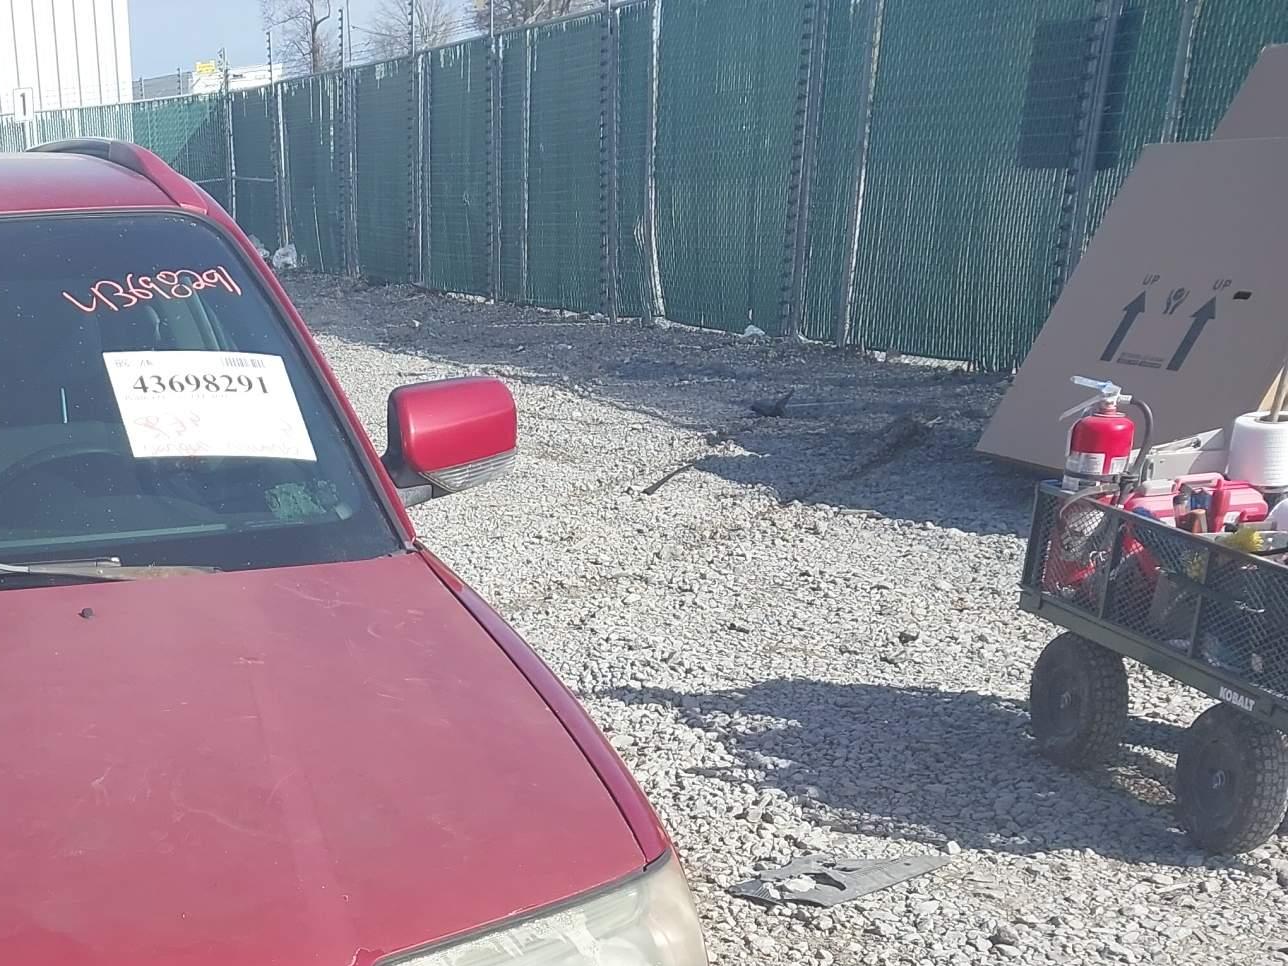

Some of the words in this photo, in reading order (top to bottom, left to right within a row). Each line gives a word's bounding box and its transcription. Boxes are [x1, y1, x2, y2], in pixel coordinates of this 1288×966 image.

[1142, 274, 1161, 286] UP
[1212, 279, 1233, 291] UP
[132, 373, 269, 395] 43698291
[1218, 686, 1256, 712] KOBALT
